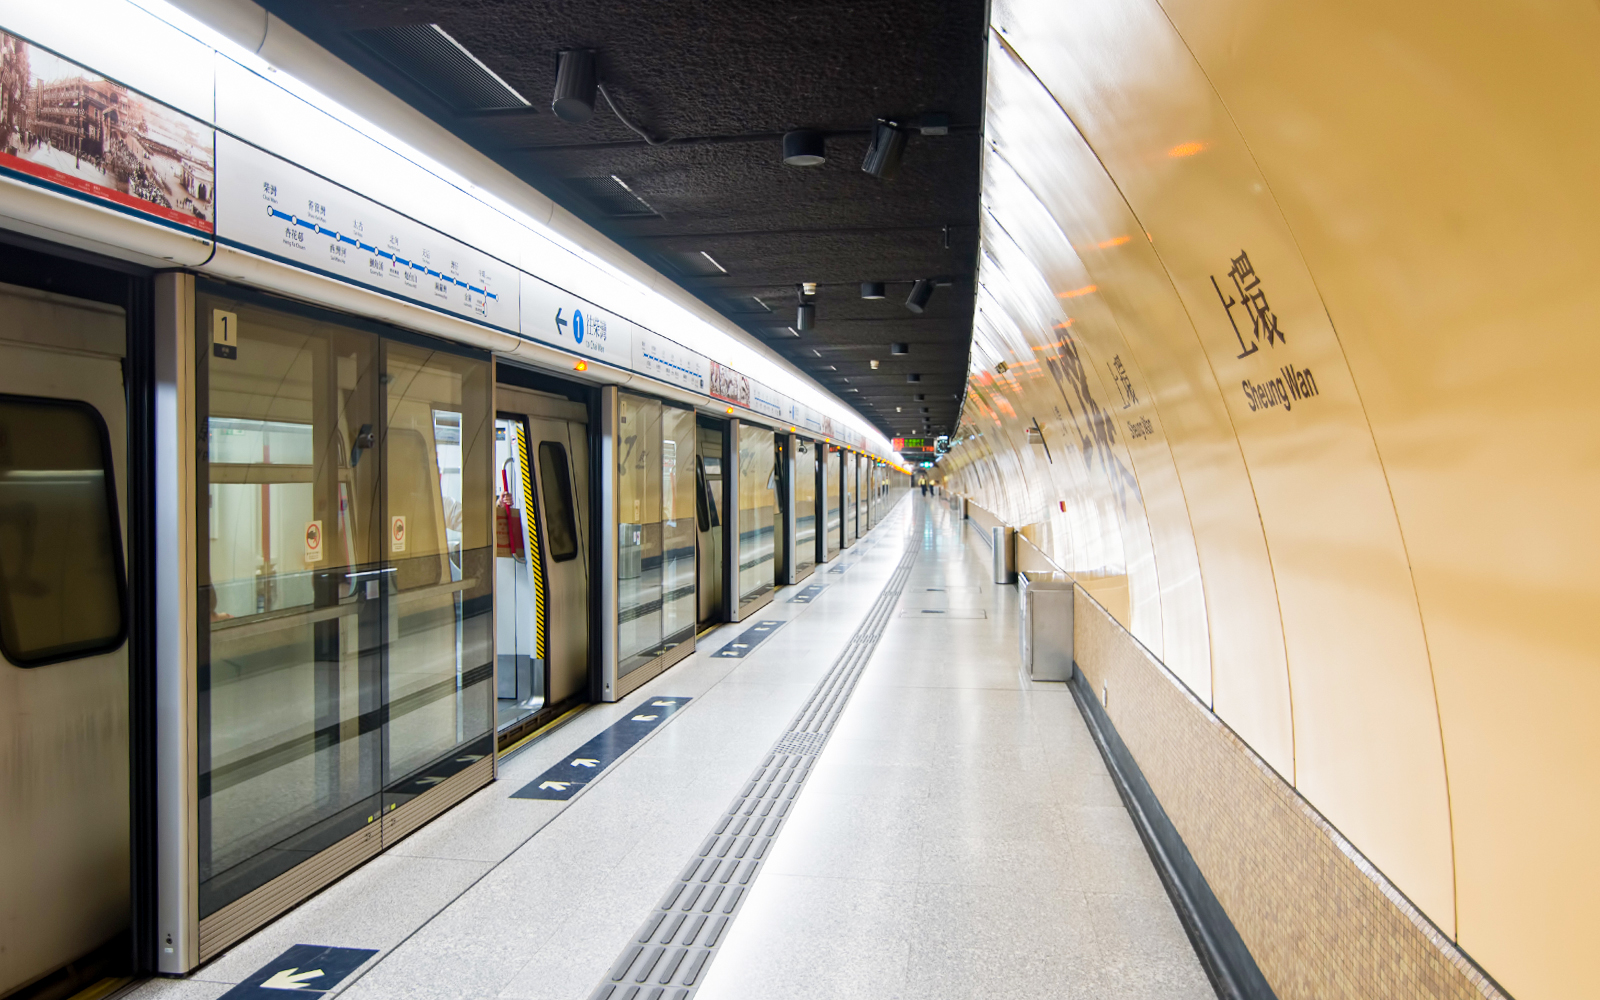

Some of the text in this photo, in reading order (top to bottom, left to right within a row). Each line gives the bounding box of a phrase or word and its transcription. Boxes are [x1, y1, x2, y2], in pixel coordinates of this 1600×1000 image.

[1210, 249, 1286, 359] 上環
[221, 316, 228, 341] 1
[1241, 364, 1319, 412] Sheung Wan
